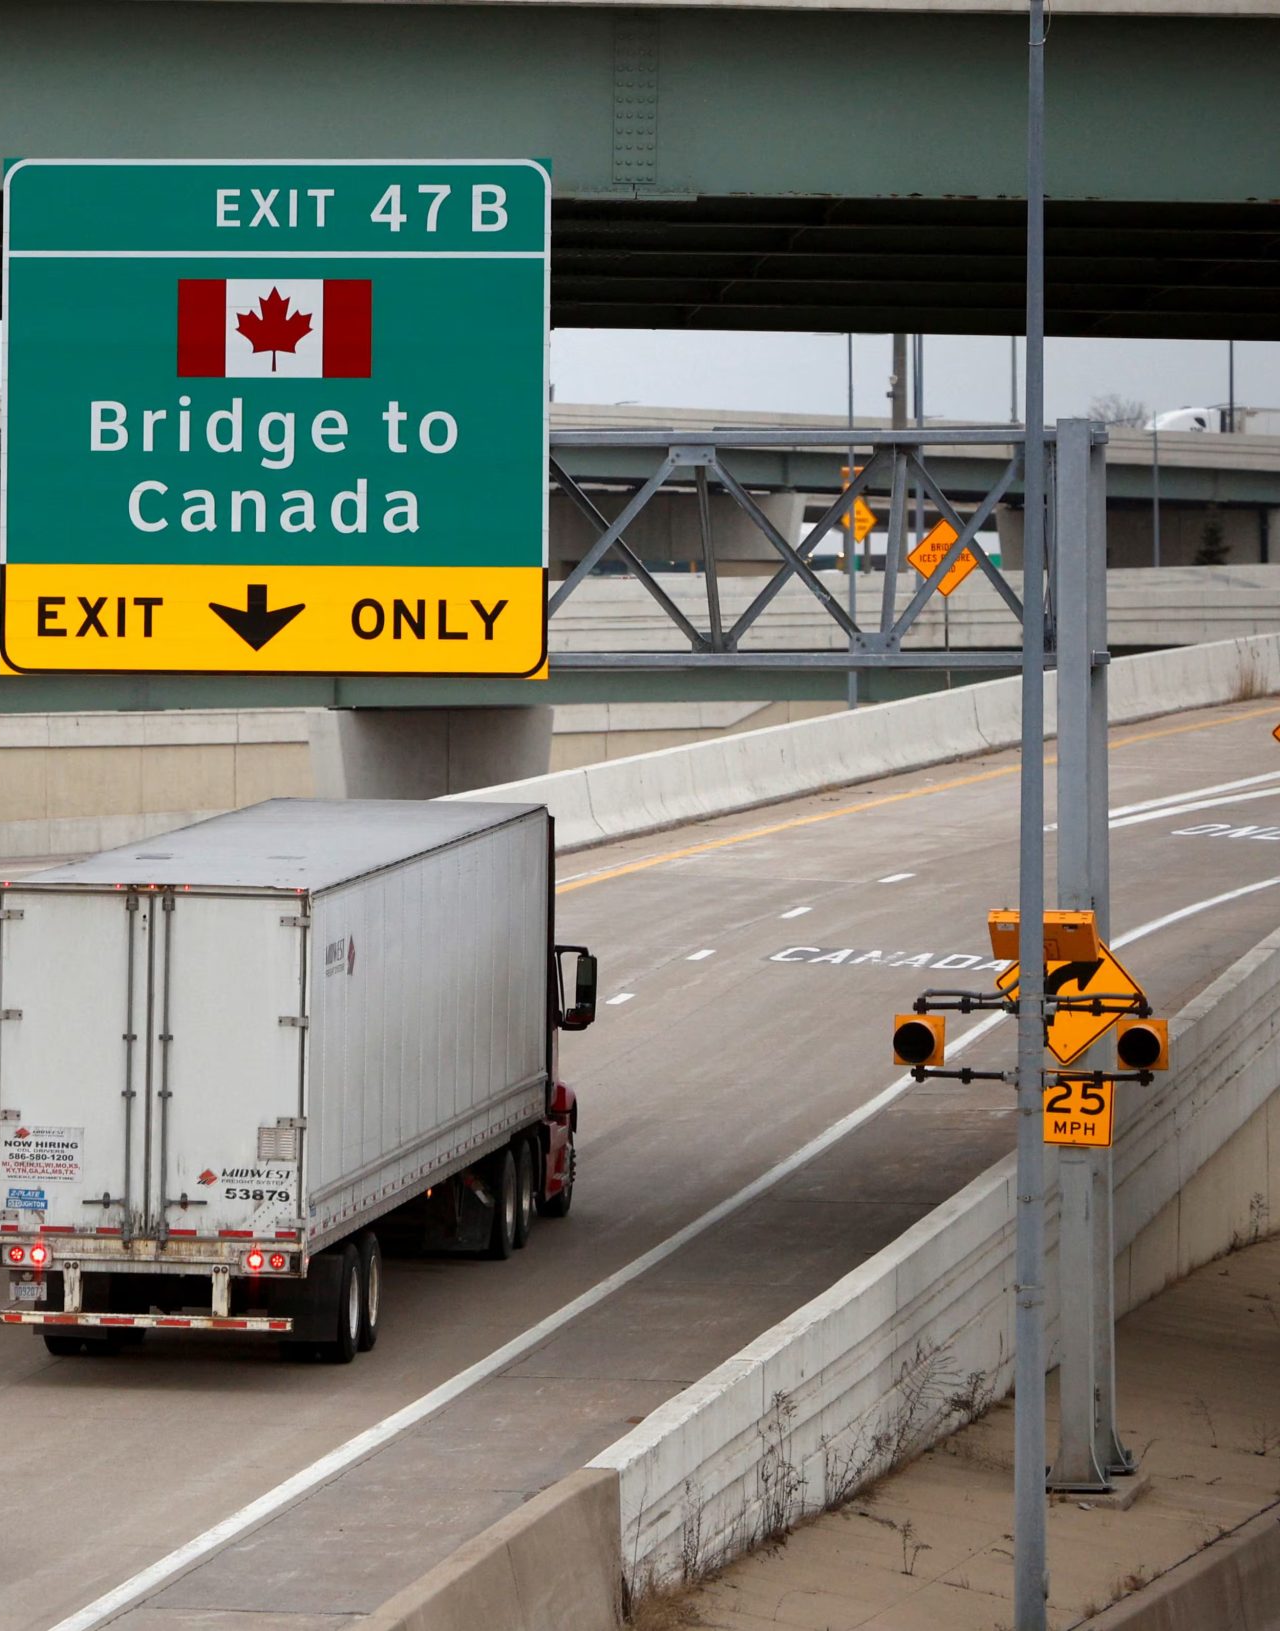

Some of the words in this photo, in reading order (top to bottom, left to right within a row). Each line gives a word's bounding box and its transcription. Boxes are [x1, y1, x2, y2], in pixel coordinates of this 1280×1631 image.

[216, 188, 335, 227] EXIT
[370, 185, 451, 232] 47
[472, 185, 508, 232] B
[90, 396, 349, 470] Bridge
[382, 401, 459, 453] to
[128, 479, 420, 533] Canada
[920, 554, 937, 562] ICES
[36, 597, 163, 637] EXIT
[351, 598, 509, 640] ONLY
[769, 946, 1012, 972] CANADA
[1046, 1081, 1105, 1115] 25
[1054, 1120, 1095, 1136] MPH
[35, 1141, 78, 1149] HIRING
[9, 1153, 74, 1161] 586-580-1200
[221, 1168, 293, 1180] MIDWEST
[225, 1188, 290, 1202] 53879
